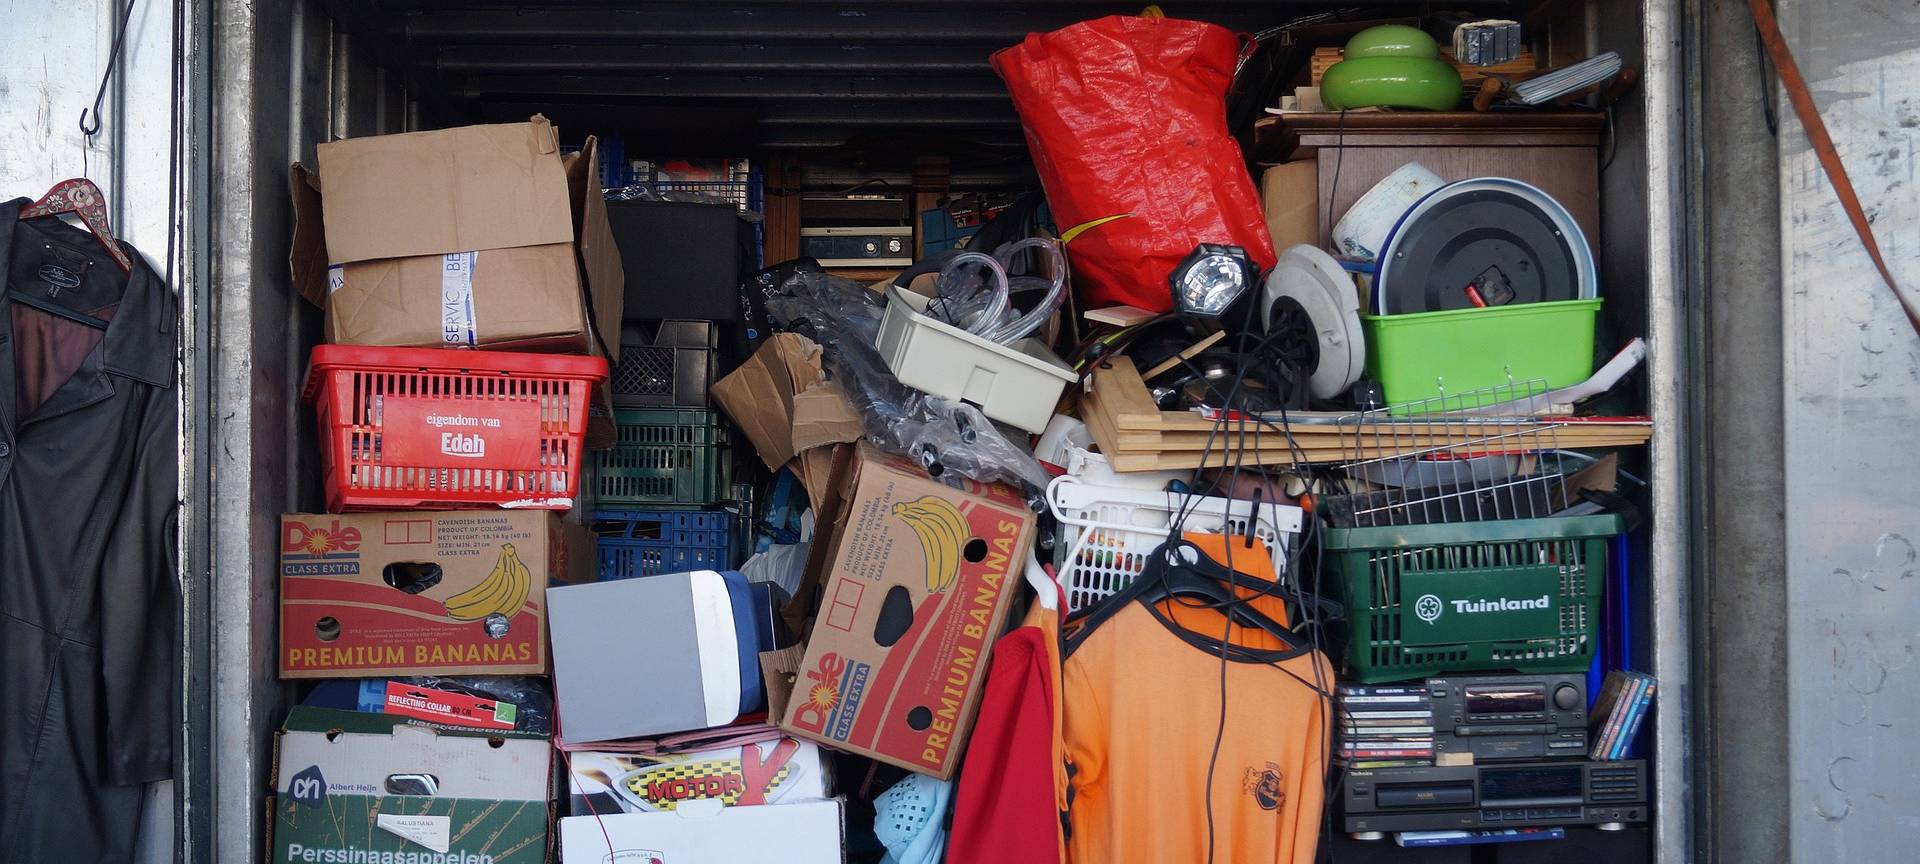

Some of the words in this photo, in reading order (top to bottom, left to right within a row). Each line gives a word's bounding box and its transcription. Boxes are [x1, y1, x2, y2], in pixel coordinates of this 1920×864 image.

[426, 413, 478, 428] eigendom
[480, 416, 500, 427] van
[441, 432, 485, 454] Edah
[283, 520, 361, 553] Dole
[844, 532, 861, 571] CAVENDISH
[856, 500, 871, 532] BANANAS
[852, 542, 866, 574] PRODUCT
[862, 532, 869, 541] OF
[866, 497, 880, 531] COLOMBIA
[285, 565, 318, 574] CLASS
[322, 564, 358, 573] EXTRA
[859, 562, 868, 577] NET
[875, 560, 886, 581] CLASS
[882, 538, 893, 560] EXTRA
[1451, 595, 1549, 613] Tuinland
[922, 645, 976, 764] PREMIUM
[963, 519, 1019, 640] BANANAS
[289, 646, 405, 666] PREMIUM
[415, 642, 531, 664] BANANAS
[388, 694, 426, 709] REFLECTING
[426, 701, 451, 713] COLLAR
[461, 707, 472, 716] CM
[792, 652, 845, 735] Dole
[837, 704, 855, 738] CLASS
[850, 666, 868, 702] EXTRA
[356, 784, 377, 792] Heijn
[648, 774, 742, 801] MOTOR
[288, 844, 493, 864] Perssinaasappelen
